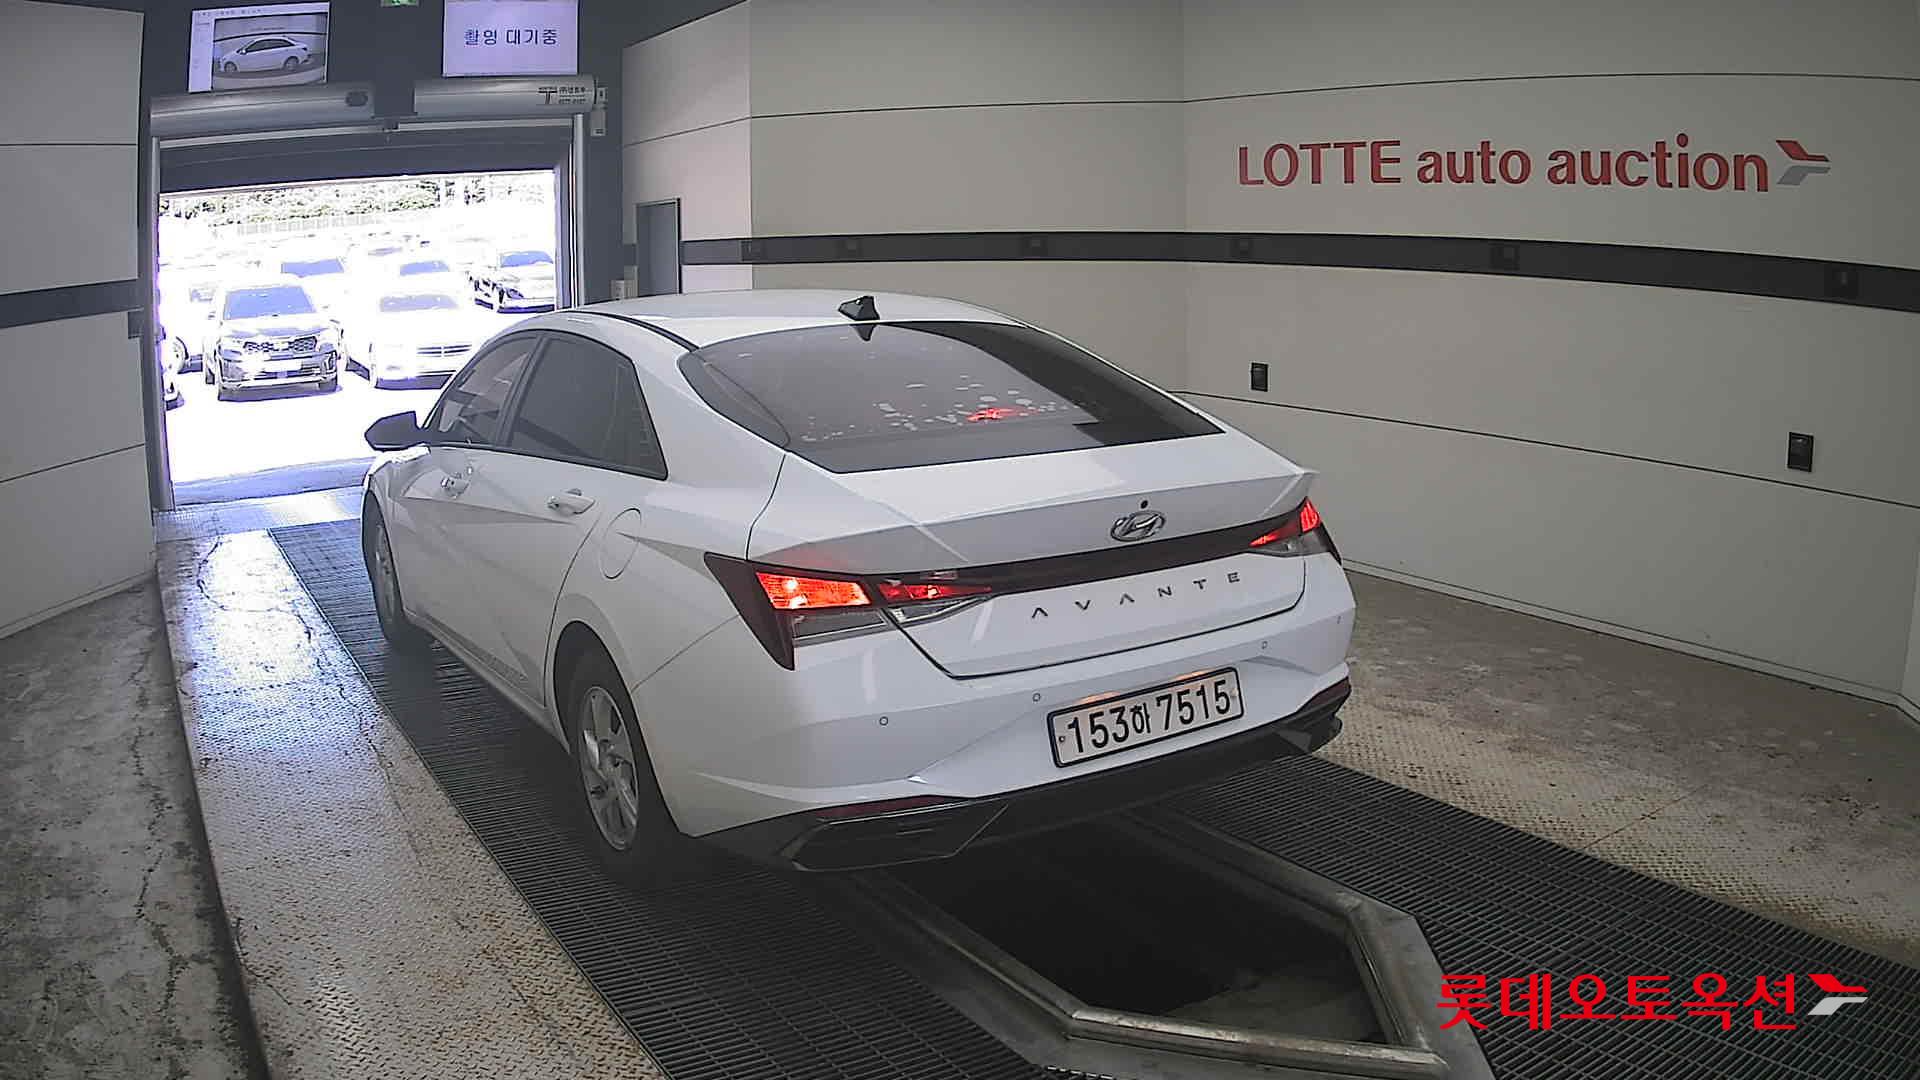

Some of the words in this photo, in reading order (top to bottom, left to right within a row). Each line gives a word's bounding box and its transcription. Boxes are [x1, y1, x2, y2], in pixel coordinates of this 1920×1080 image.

[505, 28, 558, 46] 대기중
[1238, 140, 1402, 187] LOTTE
[1416, 140, 1532, 185] auto
[1546, 132, 1770, 193] auction
[1031, 571, 1241, 618] AVANTE
[1156, 679, 1231, 731] 7515
